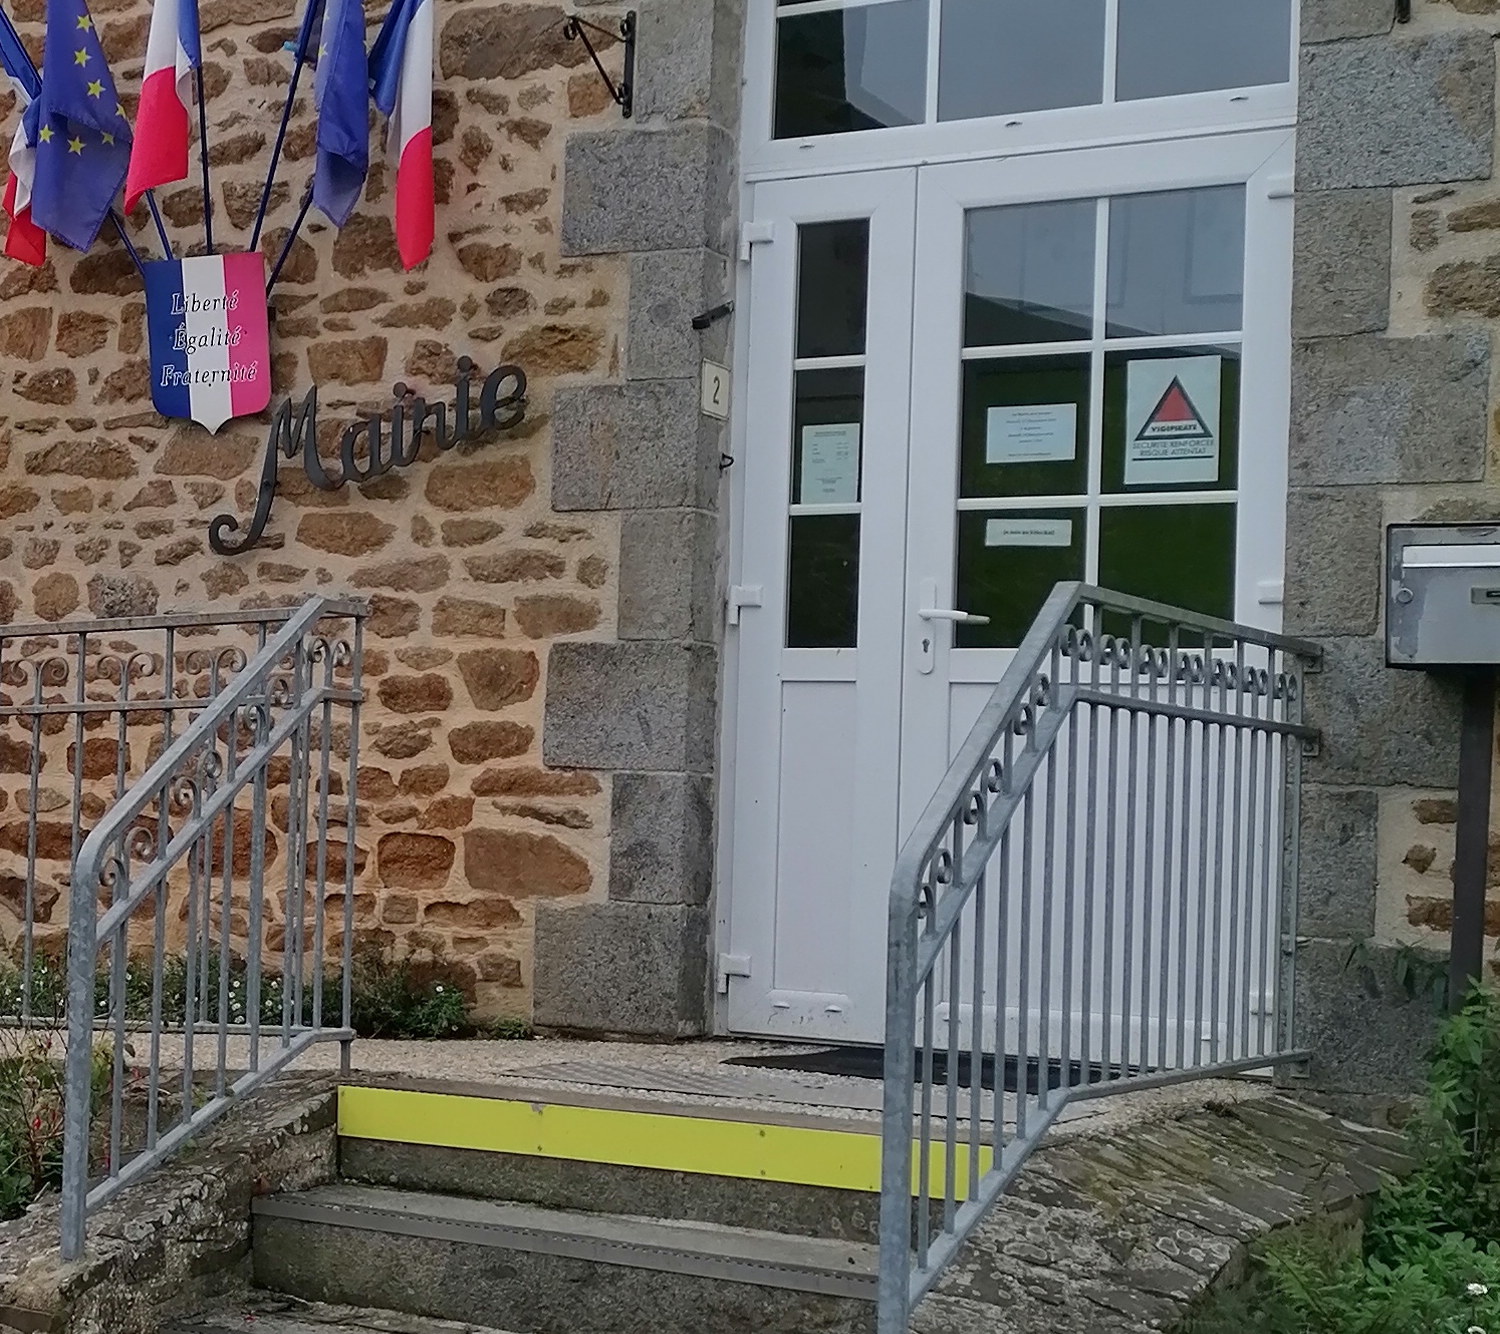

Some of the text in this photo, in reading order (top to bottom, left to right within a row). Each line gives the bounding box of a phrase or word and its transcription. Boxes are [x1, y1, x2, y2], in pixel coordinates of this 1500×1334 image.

[170, 289, 240, 315] Liberté
[172, 322, 243, 355] Égalité
[160, 360, 259, 387] Fraternité
[713, 375, 721, 405] 2
[1151, 424, 1198, 433] VIGIPIRATE
[209, 355, 528, 555] Mairie
[1140, 447, 1206, 457] RISQUE ATTENTAT
